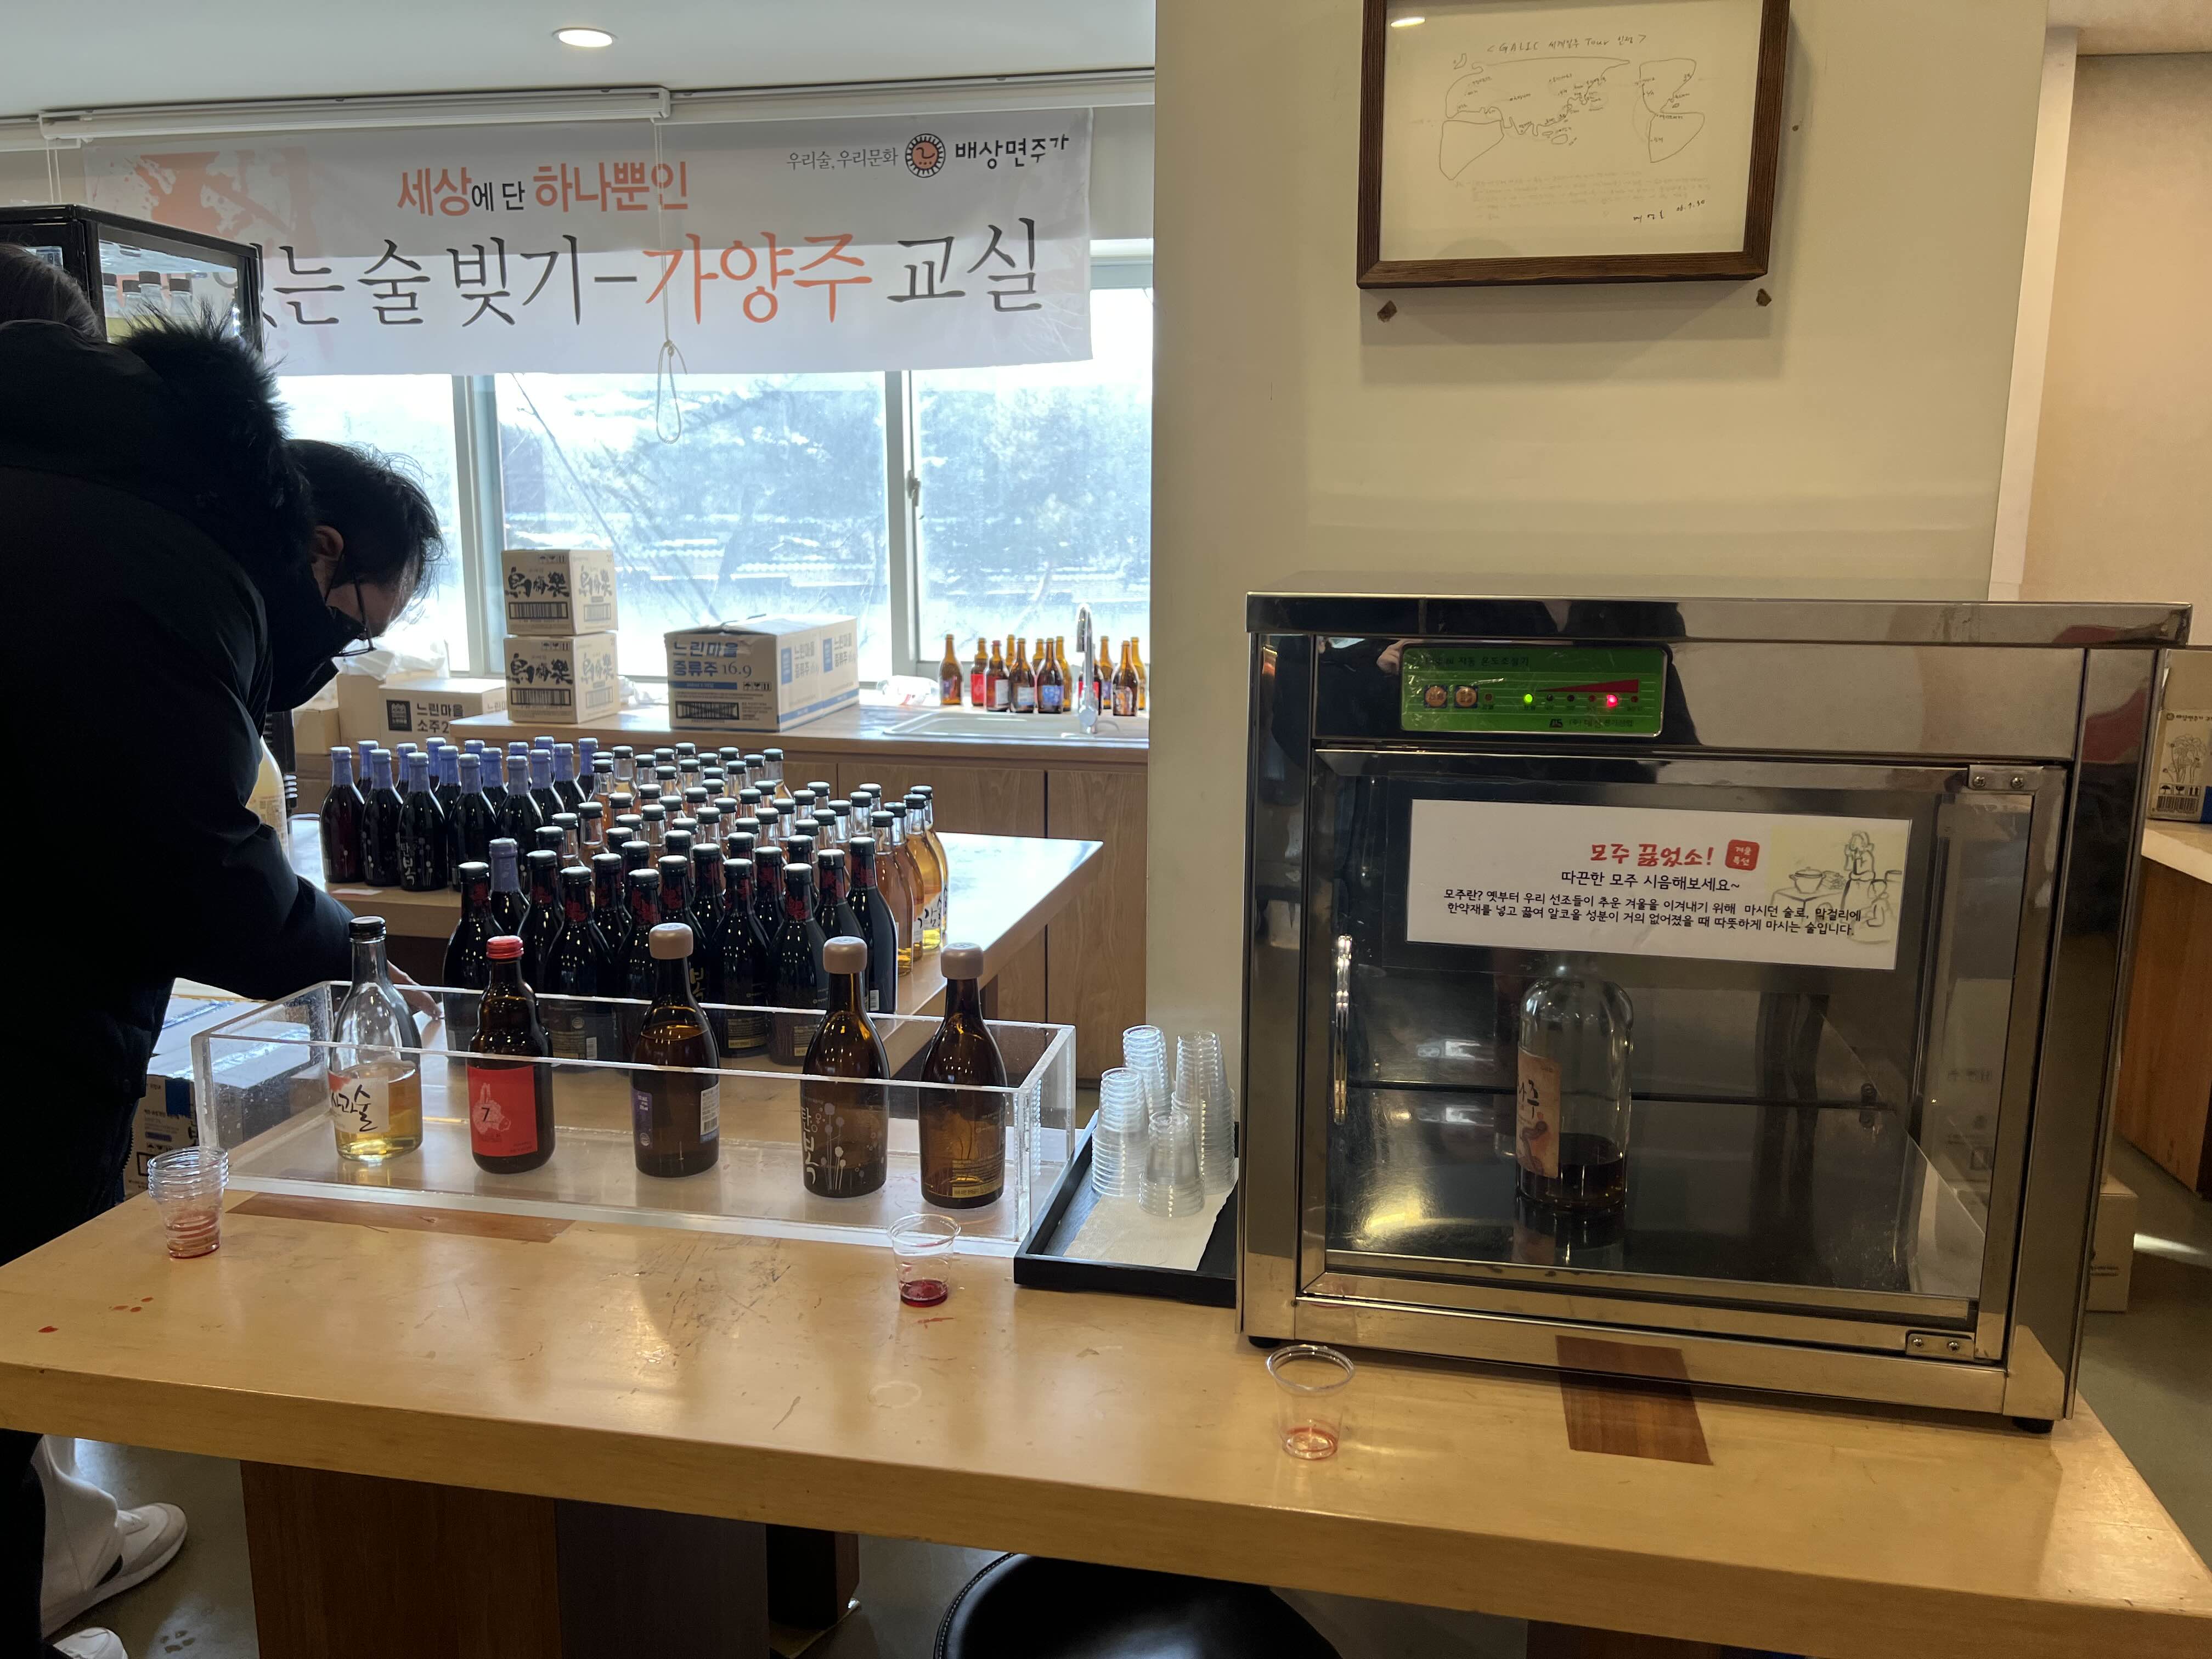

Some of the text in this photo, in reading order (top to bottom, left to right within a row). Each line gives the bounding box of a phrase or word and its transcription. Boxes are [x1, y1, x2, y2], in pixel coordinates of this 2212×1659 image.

[955, 134, 1070, 170] 배상면주가
[397, 161, 689, 217] 세상에 단 하나뿐인
[357, 239, 431, 325] 술
[885, 217, 1043, 313] 교실
[673, 640, 738, 658] 느린마을
[673, 660, 752, 678] 증류주 16.9
[417, 702, 464, 718] 느린마을
[1590, 843, 1714, 867] 모주 끓었소!
[1561, 870, 1740, 891] 따끈한 모주 시음해보세요~
[1443, 889, 1861, 922] 모주란? 옛부터 우리 선조들이 추운 겨울을 이겨내기 위해 마시던 술로, 막걸리에
[1447, 902, 1854, 935] 한약재를 넣고 끓여 알코올 성분이 거의 없어졌을 때 따뜻하게 마시는 술입니다.
[331, 1084, 379, 1132] 사과술
[481, 1107, 490, 1122] 7
